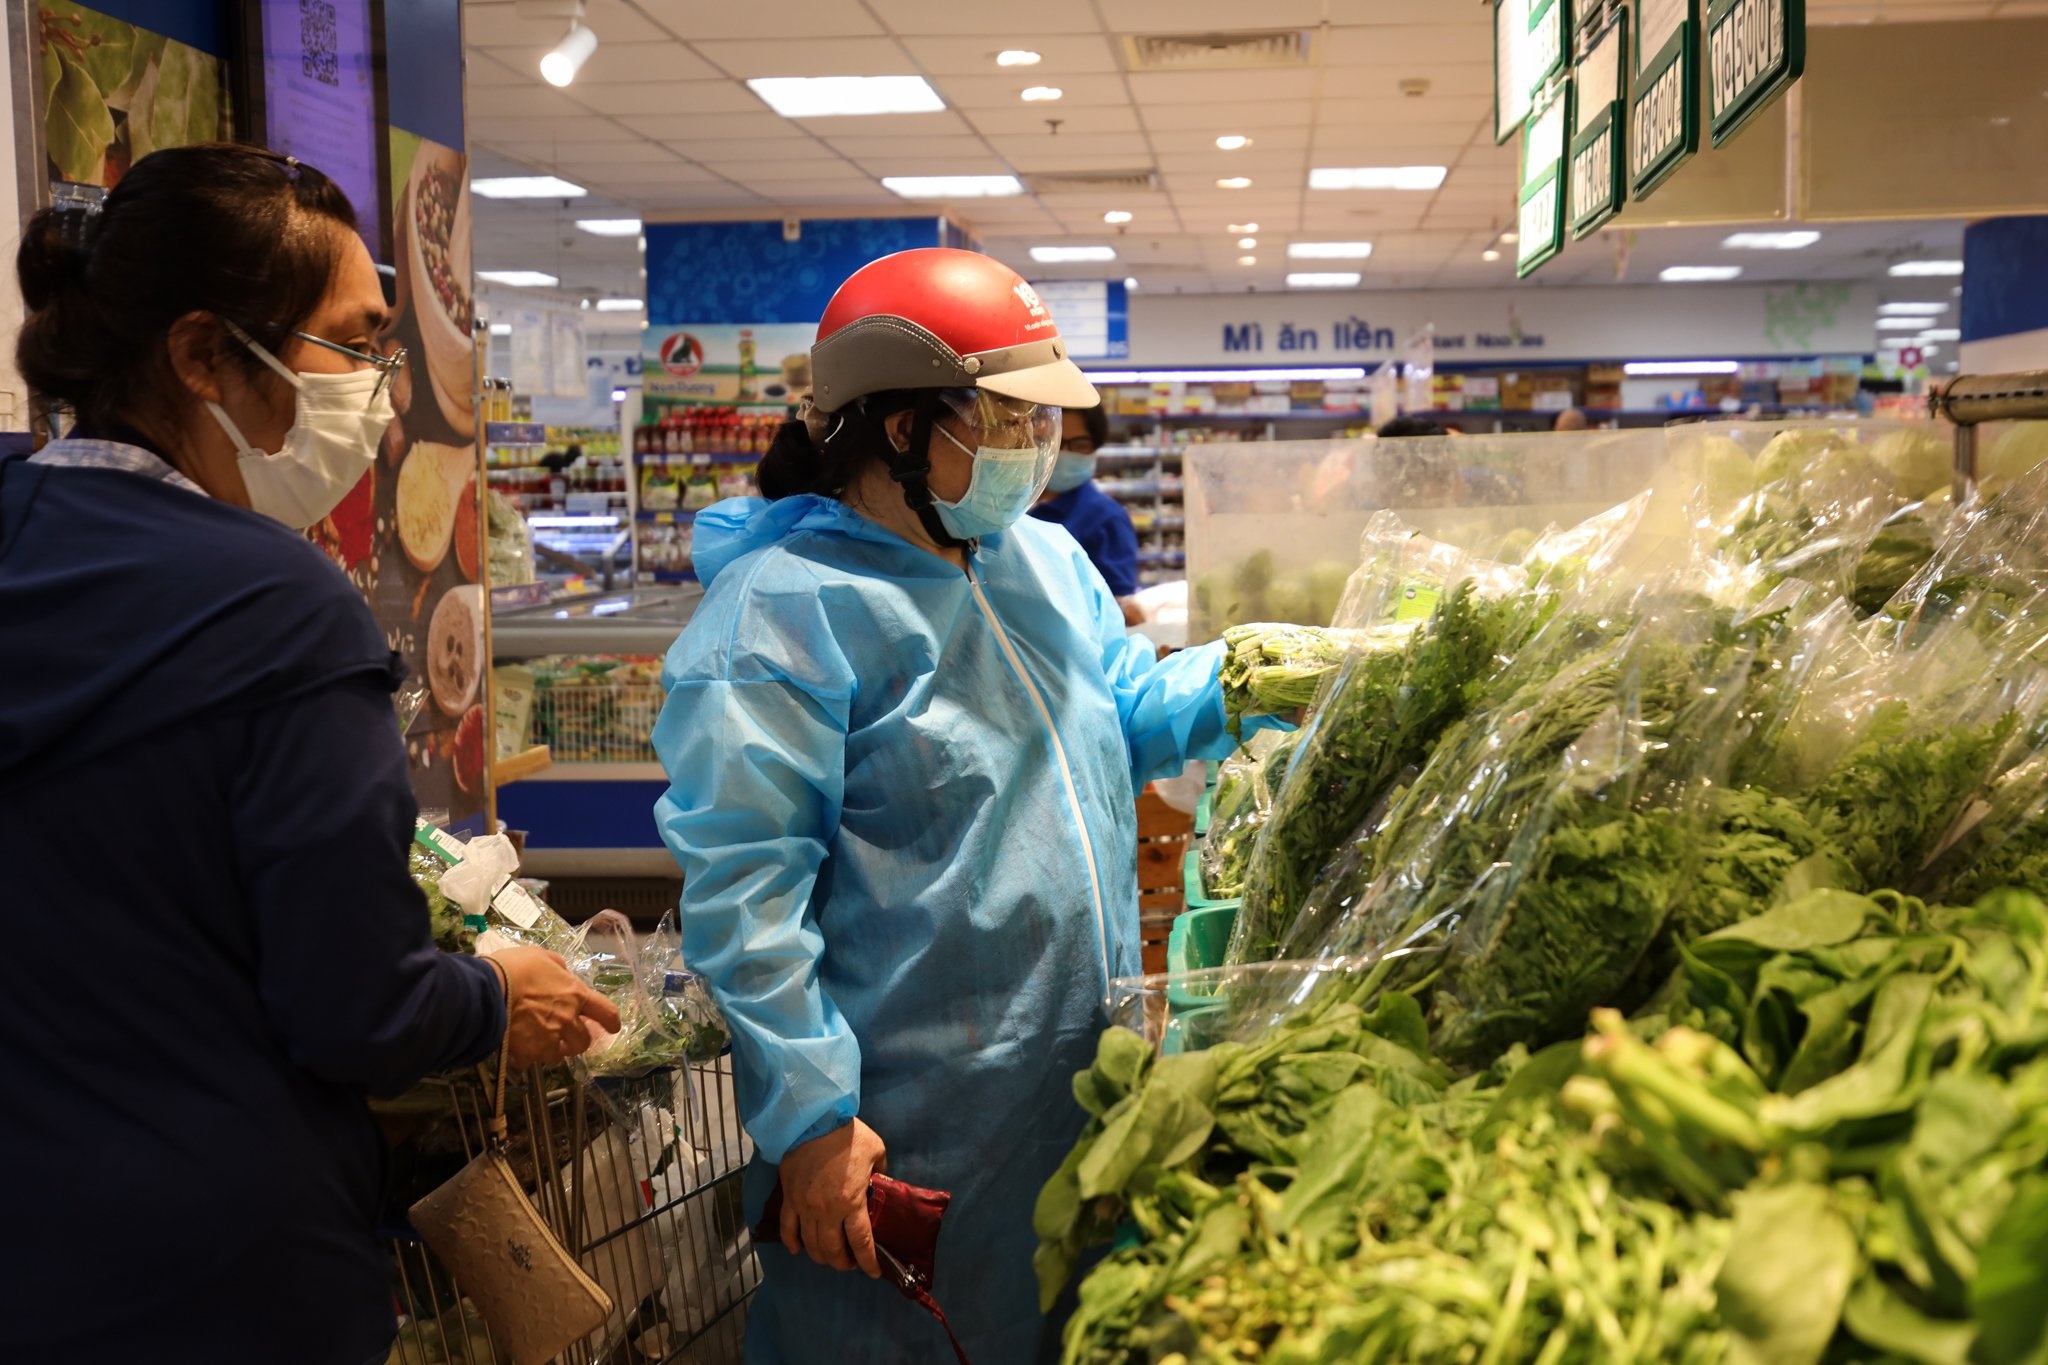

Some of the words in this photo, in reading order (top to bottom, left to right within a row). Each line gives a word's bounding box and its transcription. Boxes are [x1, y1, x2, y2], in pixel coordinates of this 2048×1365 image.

[1223, 322, 1262, 351] Mì
[1278, 322, 1318, 351] ăn
[1333, 315, 1394, 350] liền
